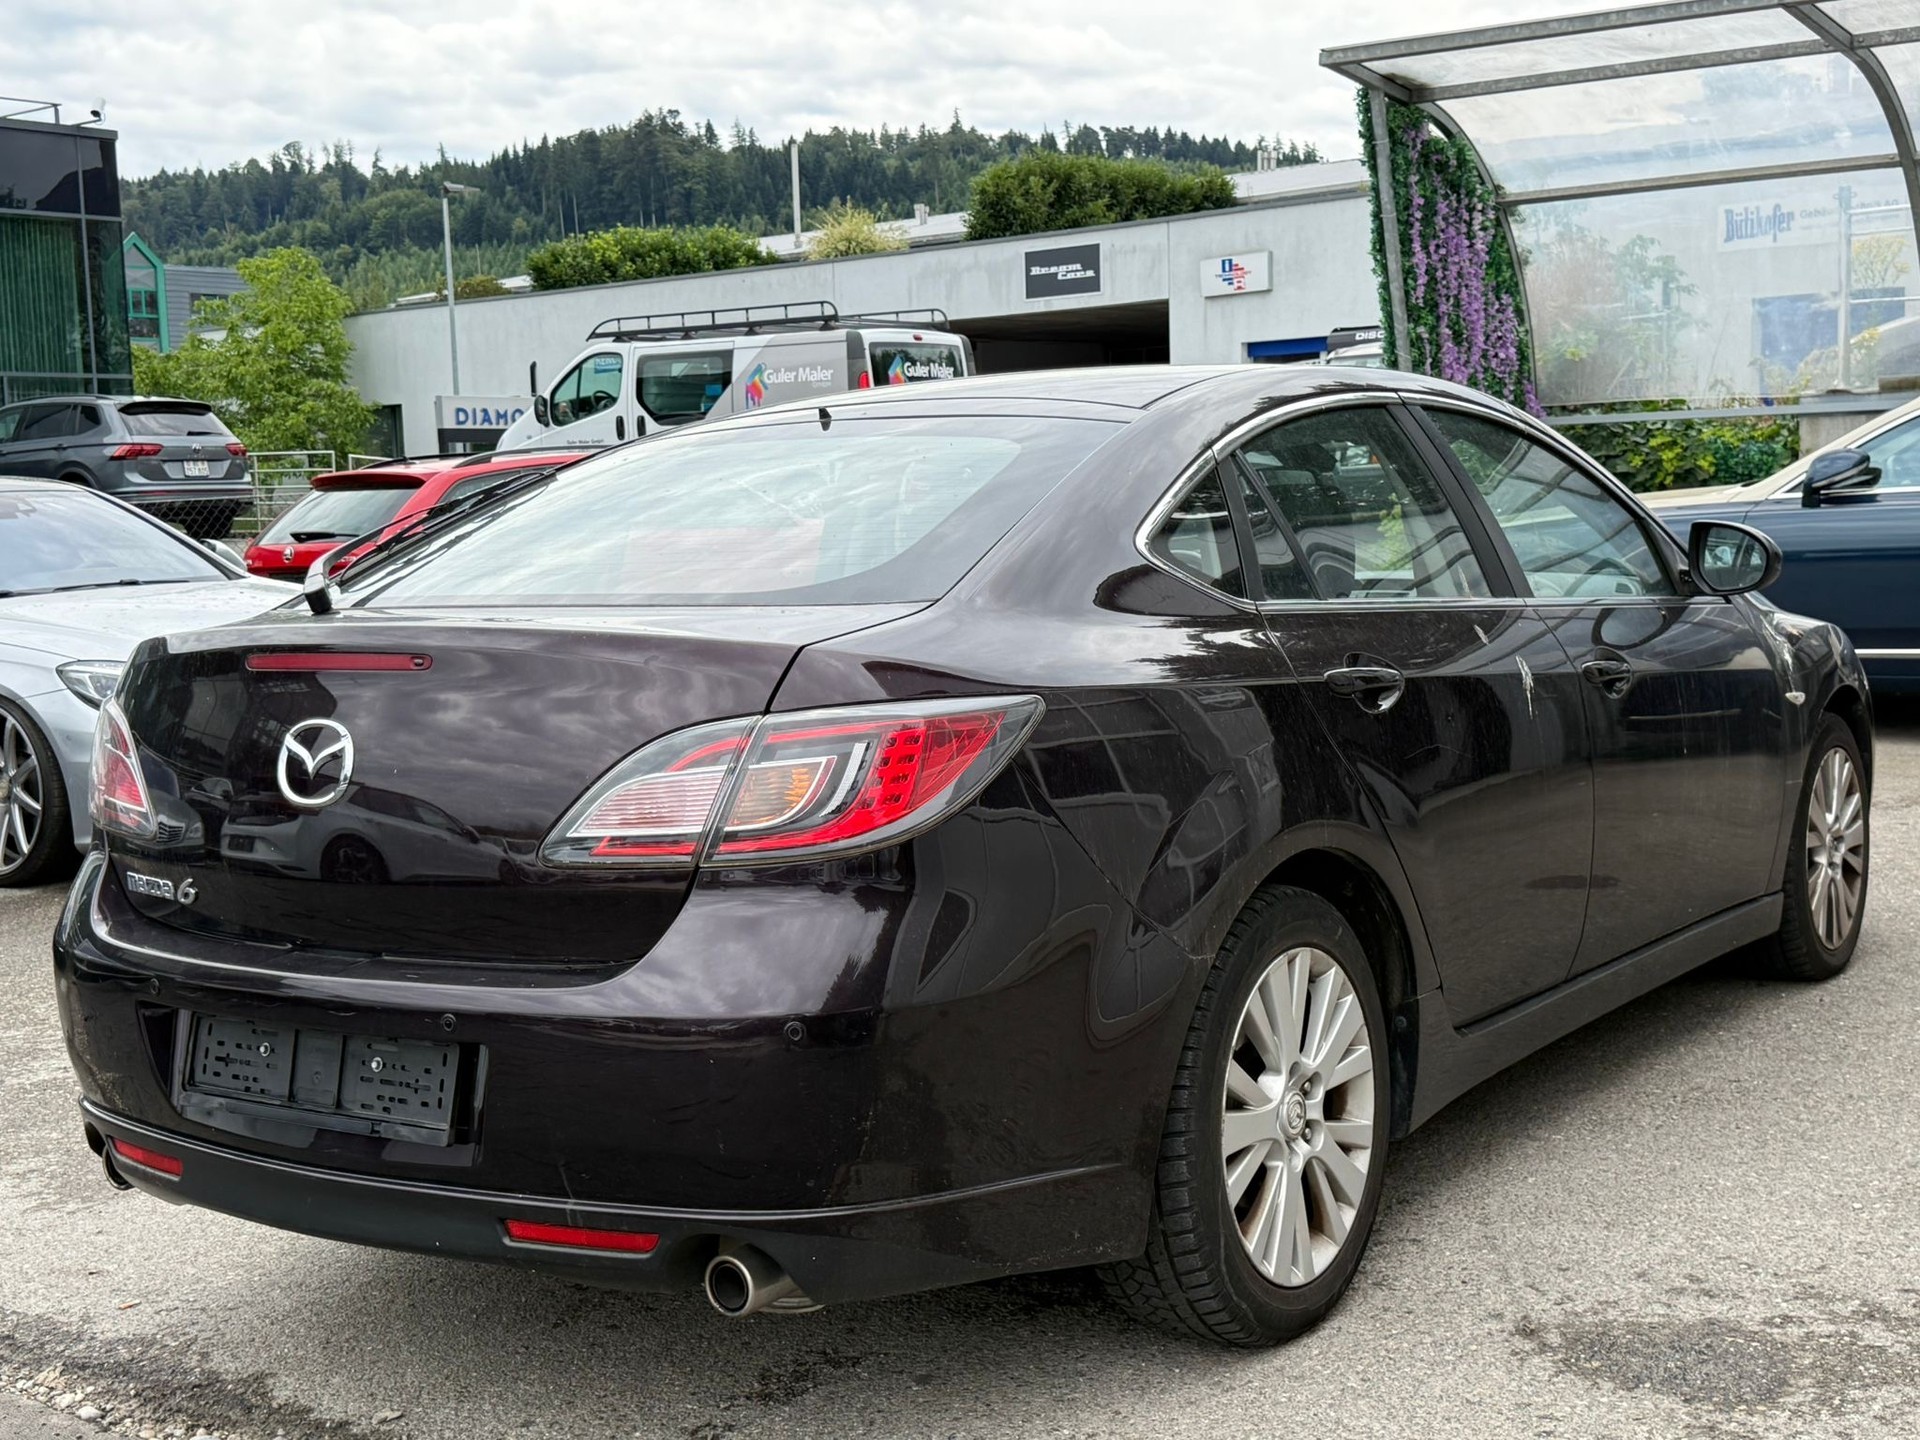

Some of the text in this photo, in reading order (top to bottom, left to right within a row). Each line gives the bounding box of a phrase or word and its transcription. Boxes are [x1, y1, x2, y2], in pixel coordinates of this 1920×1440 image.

[764, 365, 834, 384] Guler Maler
[177, 878, 199, 905] 6
